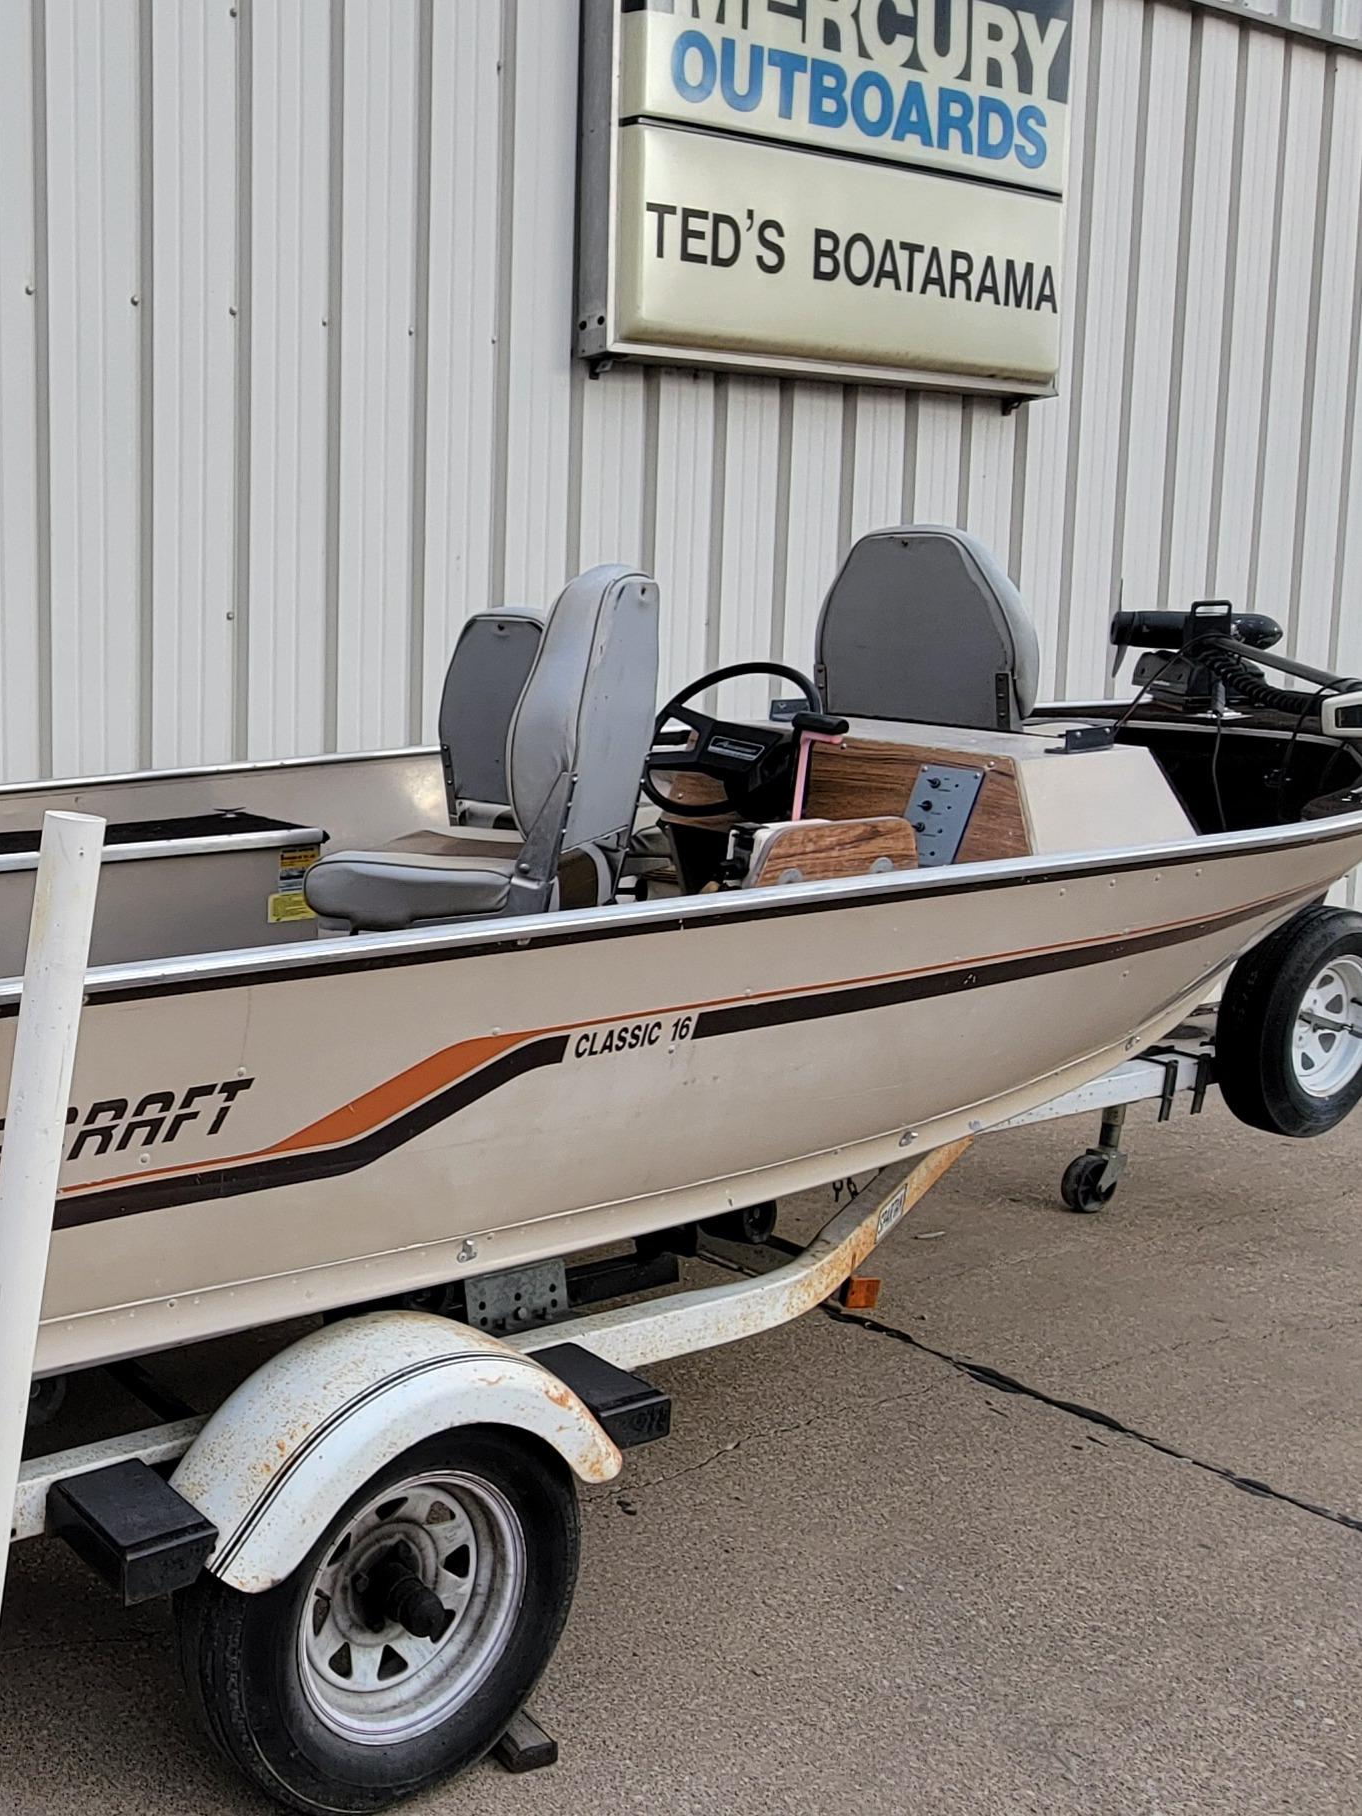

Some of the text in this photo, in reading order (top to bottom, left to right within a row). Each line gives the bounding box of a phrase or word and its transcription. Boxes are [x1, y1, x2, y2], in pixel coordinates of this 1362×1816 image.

[670, 29, 1047, 169] OUTBOARDS
[646, 202, 1059, 314] TED'S BOATARAMA
[574, 1016, 693, 1059] CLASSIC 16
